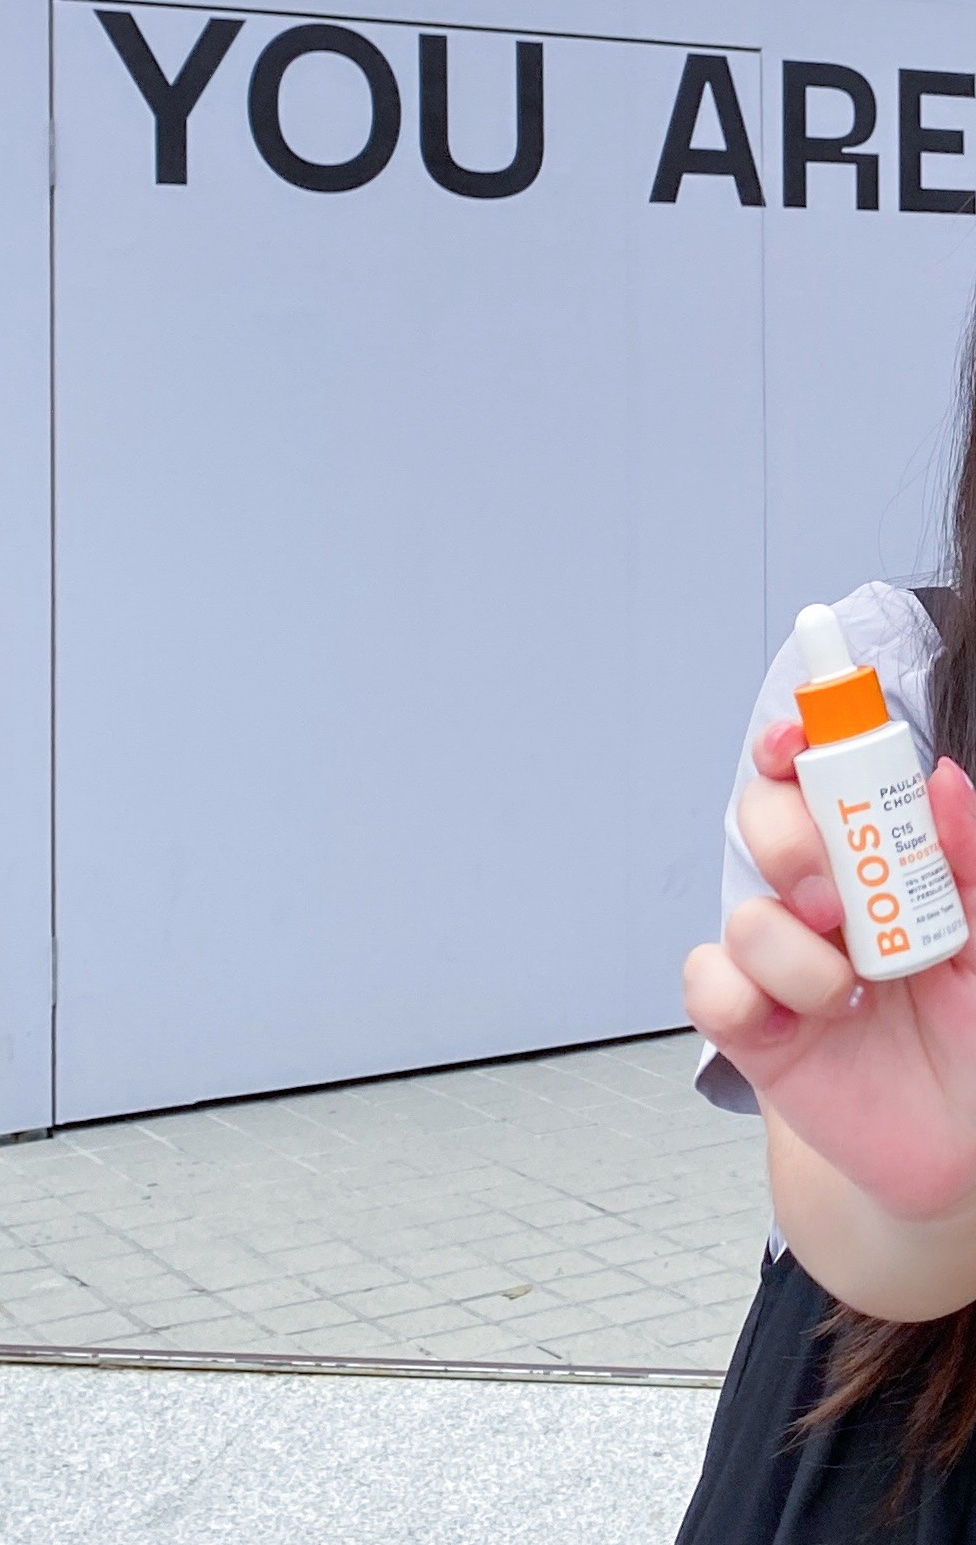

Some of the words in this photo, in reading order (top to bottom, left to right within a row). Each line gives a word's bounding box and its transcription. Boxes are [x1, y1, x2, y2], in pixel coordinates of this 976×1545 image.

[94, 9, 544, 199] YOU
[650, 53, 976, 215] ARE
[883, 787, 926, 811] CHOICE
[891, 822, 914, 840] C15
[895, 833, 927, 854] Super
[837, 798, 911, 958] BOOST
